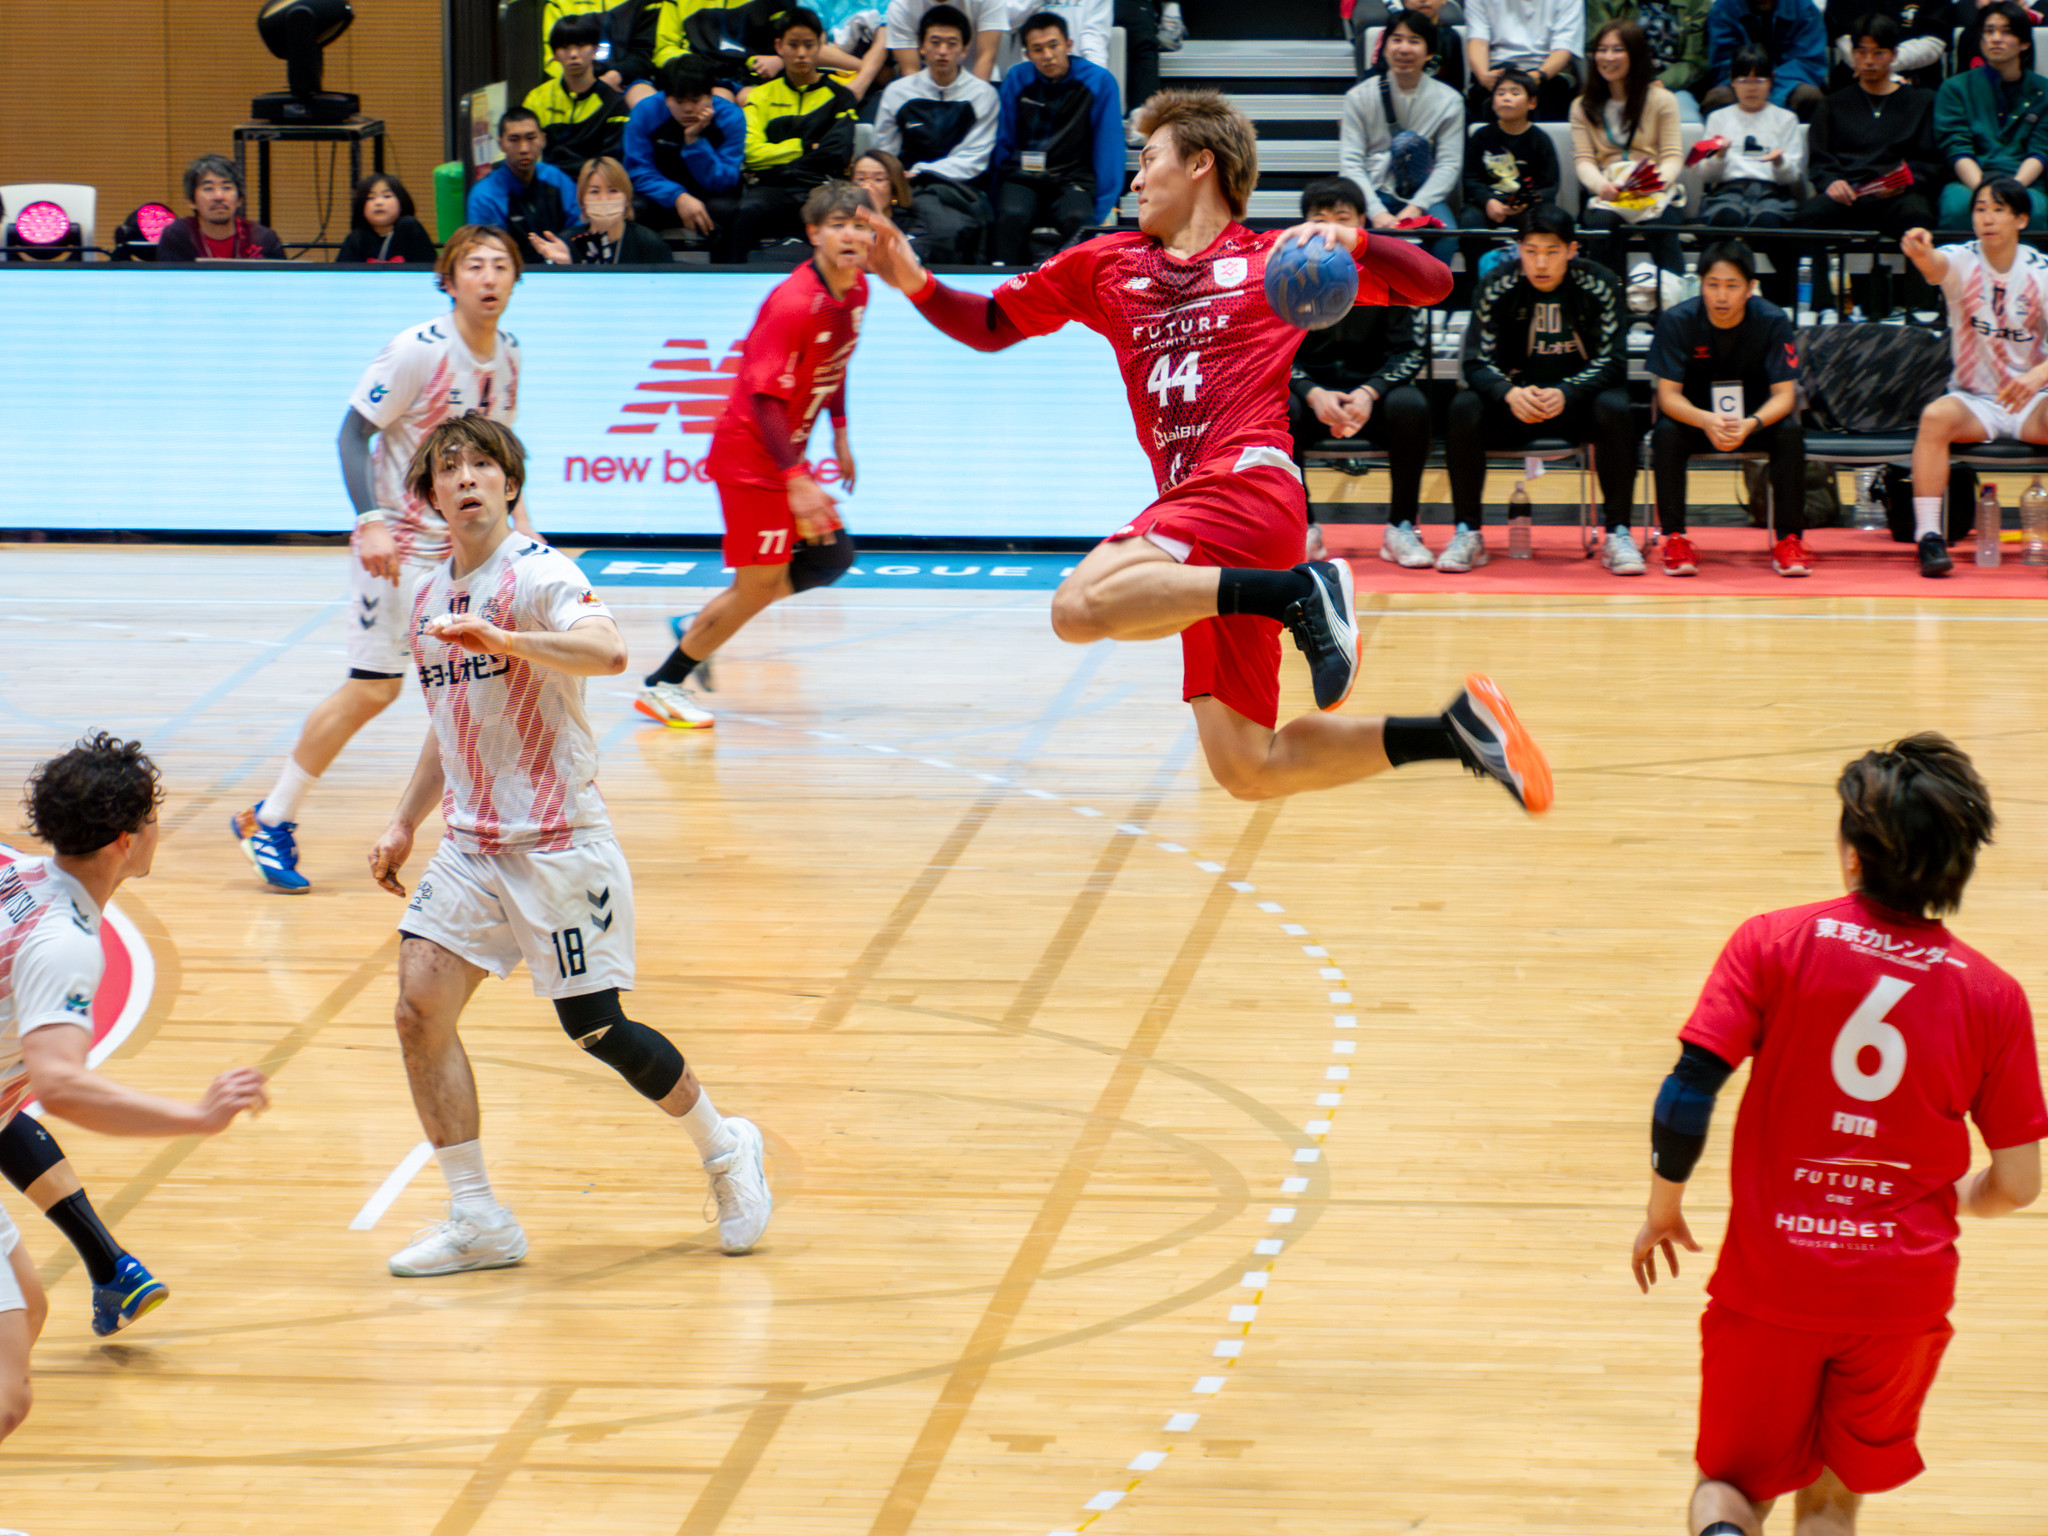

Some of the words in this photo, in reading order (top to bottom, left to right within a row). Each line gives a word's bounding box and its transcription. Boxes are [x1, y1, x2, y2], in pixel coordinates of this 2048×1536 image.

[1132, 315, 1230, 341] FUTURE
[1147, 350, 1203, 408] 44
[1719, 395, 1736, 412] C
[565, 456, 652, 483] new
[551, 927, 587, 979] 18
[1815, 917, 1969, 969] 東京カレンダー
[1830, 974, 1917, 1102] 6
[1831, 1110, 1878, 1139] FUTA
[1793, 1167, 1894, 1196] FUTURE
